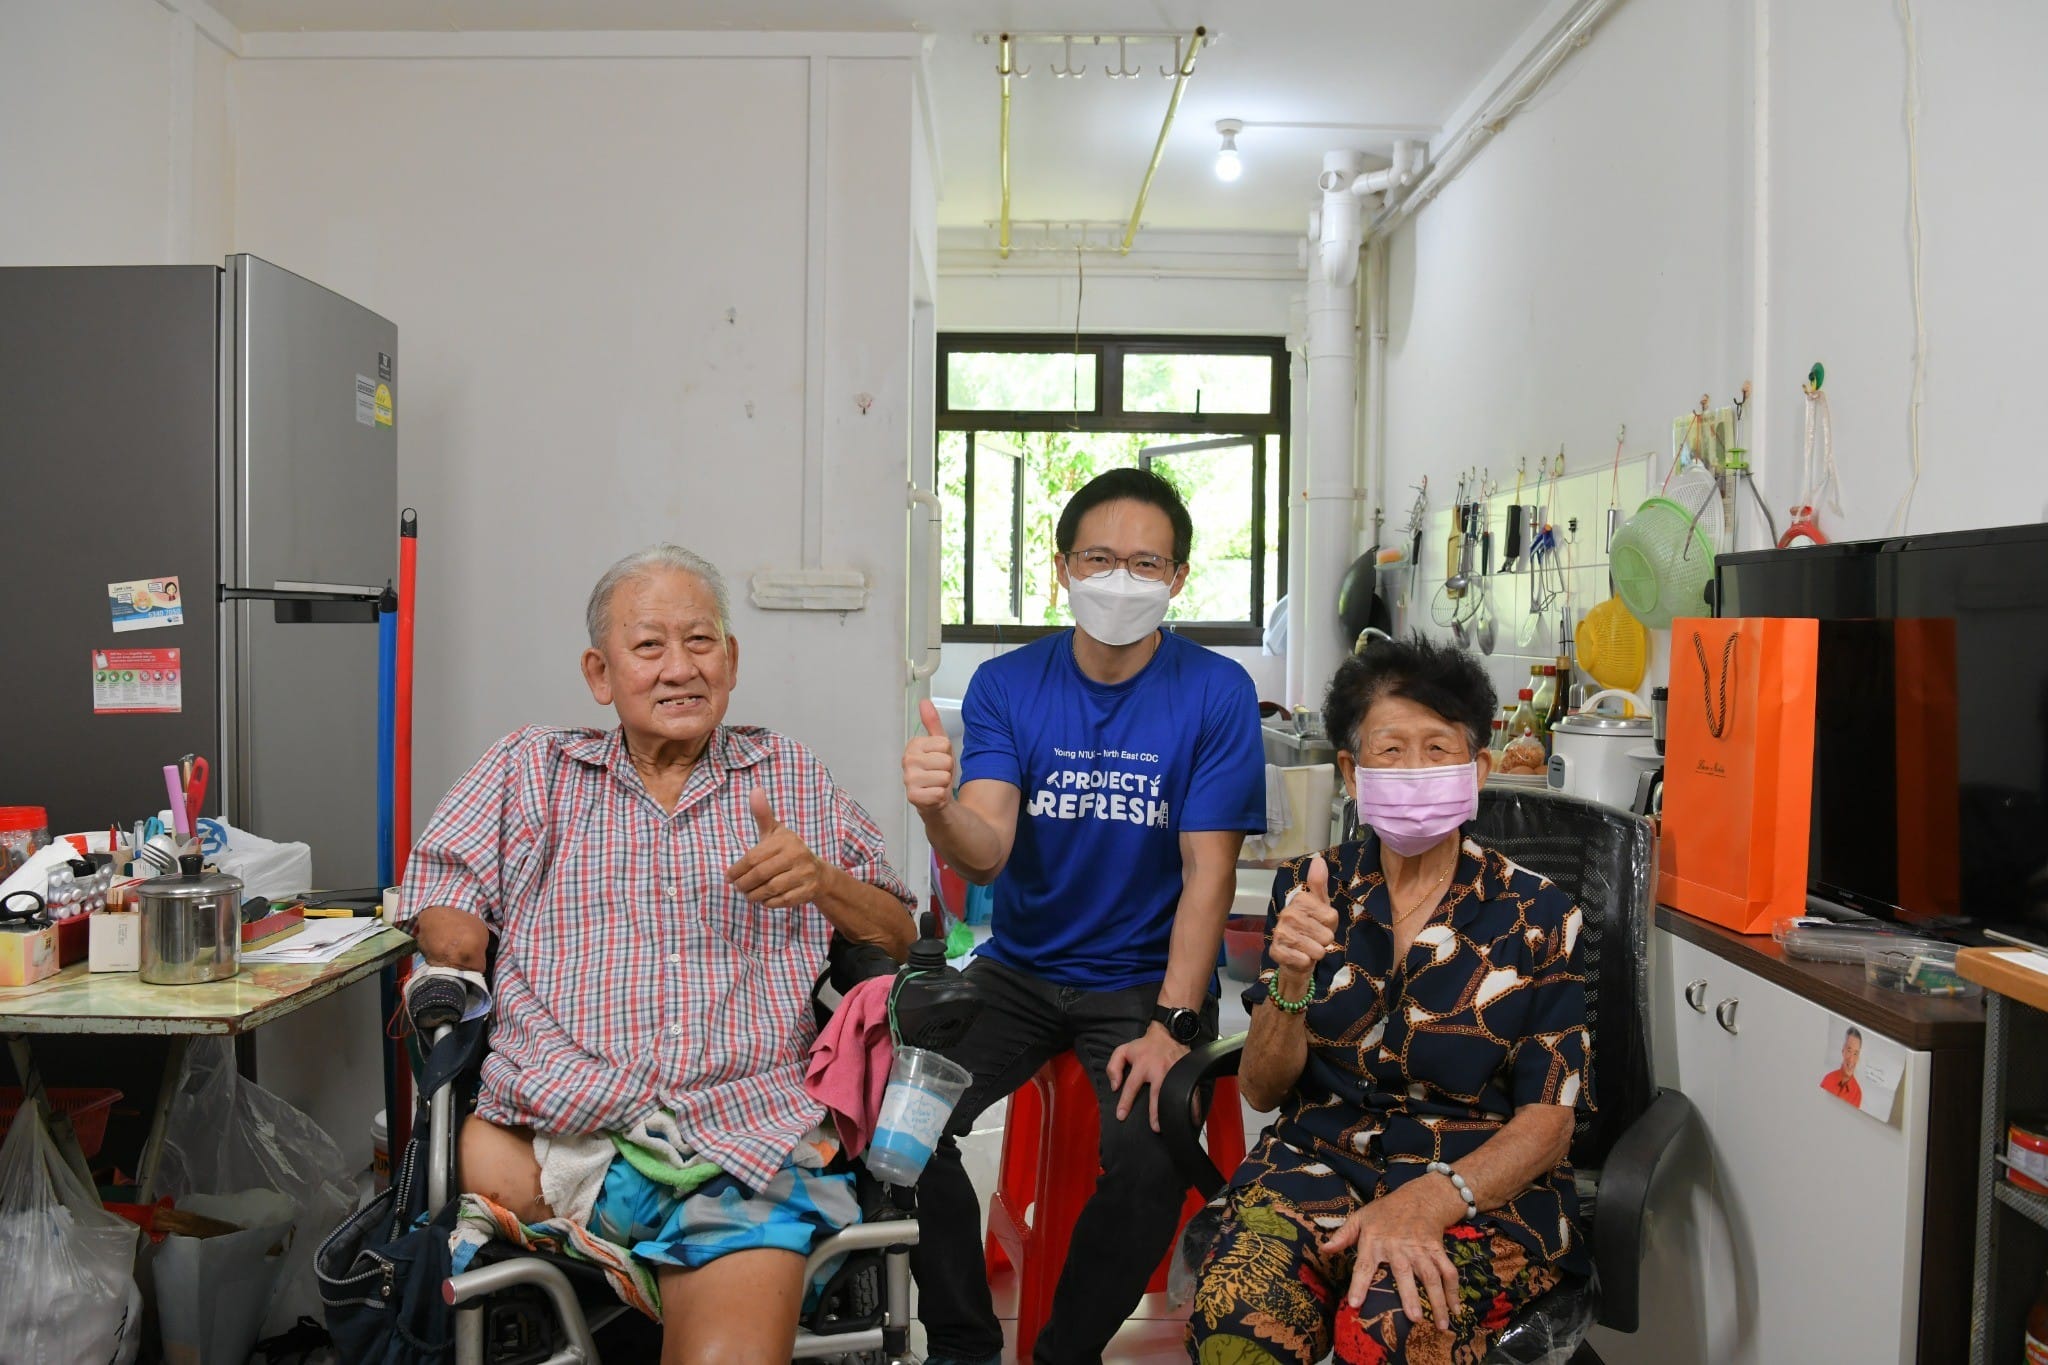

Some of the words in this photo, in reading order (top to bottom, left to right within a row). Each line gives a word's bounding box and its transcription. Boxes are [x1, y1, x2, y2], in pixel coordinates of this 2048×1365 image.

[1078, 750, 1096, 760] NTU
[1103, 749, 1120, 758] Nrth
[1121, 750, 1139, 760] East
[1140, 752, 1159, 763] CDC
[1061, 770, 1148, 793] PROJECT
[1036, 790, 1169, 829] REFRESH
